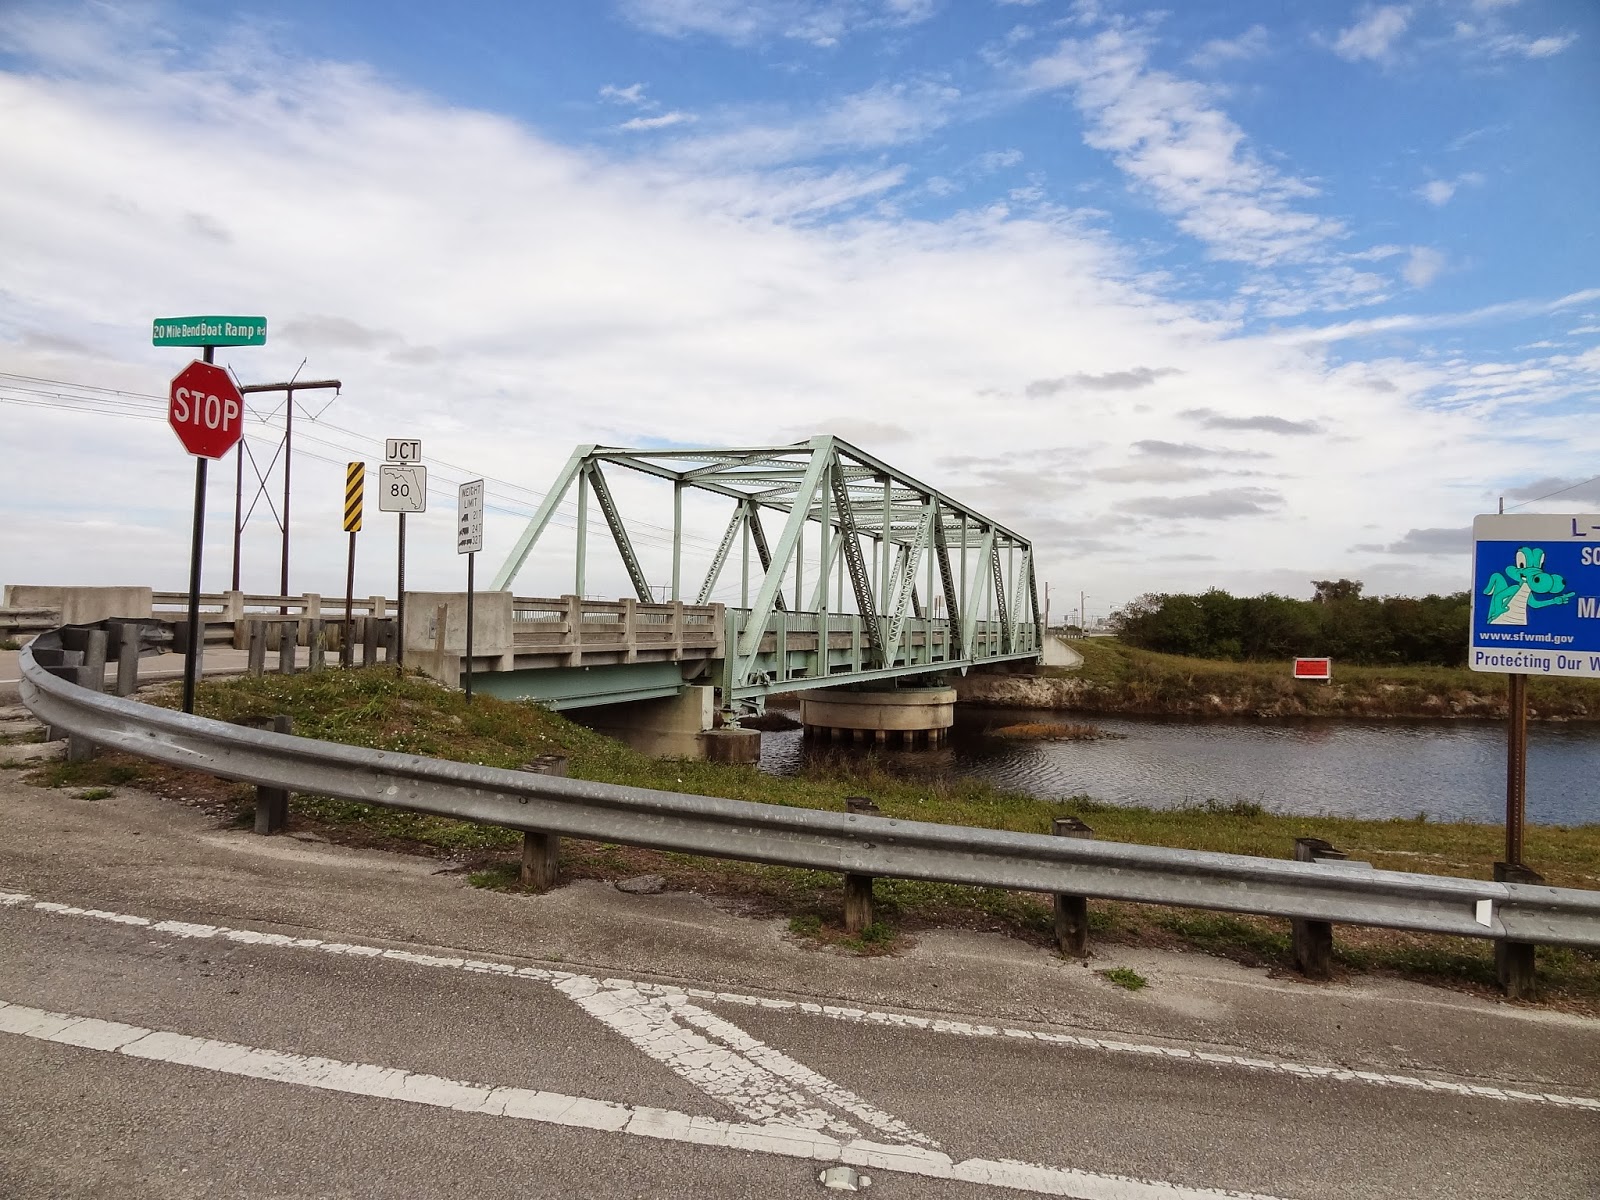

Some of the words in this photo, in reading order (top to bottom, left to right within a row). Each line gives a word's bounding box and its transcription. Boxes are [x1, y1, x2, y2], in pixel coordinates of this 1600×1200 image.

[153, 325, 164, 338] 20
[166, 325, 181, 338] Mile
[225, 322, 254, 339] Ramp
[174, 387, 239, 432] STOP
[389, 442, 418, 459] JCT
[391, 484, 409, 496] 80
[1480, 632, 1574, 644] www.sfwmd.gov
[1475, 652, 1550, 671] Protecting
[1557, 655, 1582, 670] Our
